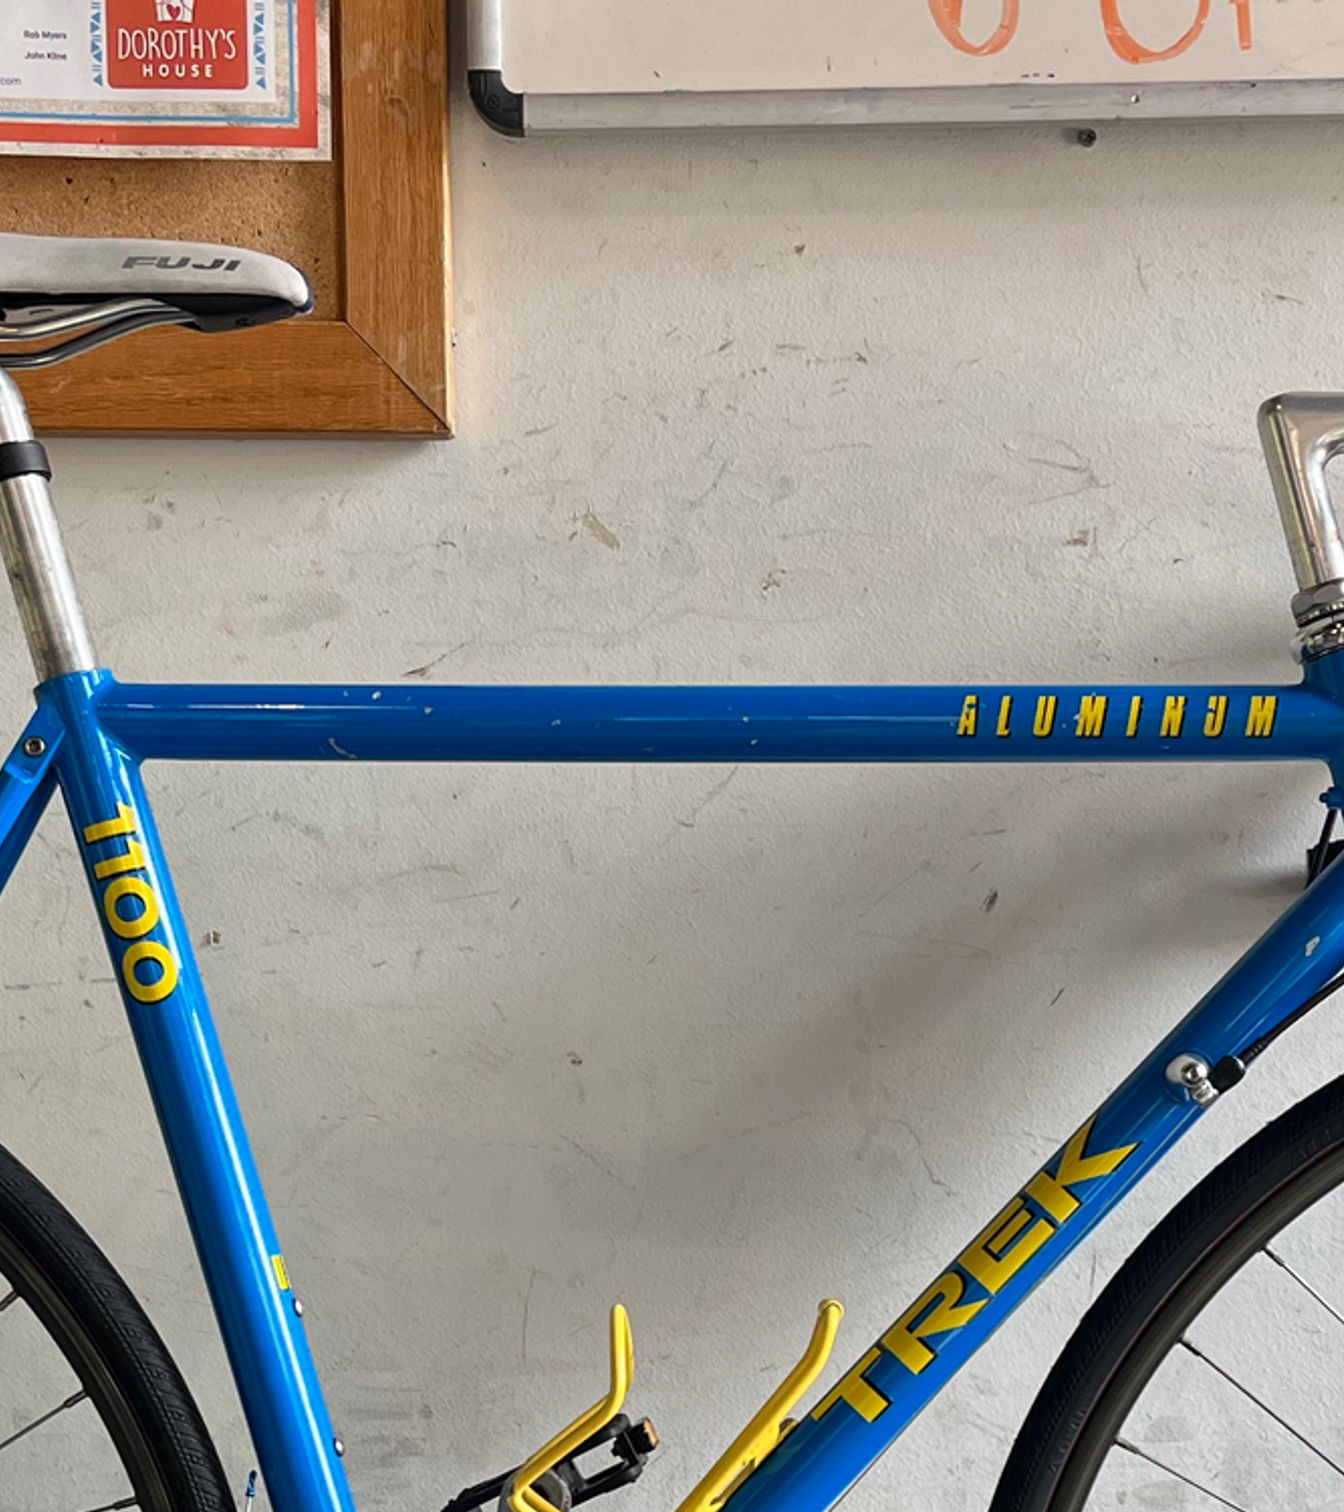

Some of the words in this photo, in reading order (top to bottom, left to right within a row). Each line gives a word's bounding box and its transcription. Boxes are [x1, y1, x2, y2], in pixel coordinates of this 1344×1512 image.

[118, 28, 237, 60] DOROTHY'S
[142, 64, 214, 78] HOUSE
[122, 256, 241, 271] FUJI
[957, 694, 1279, 738] ALUMINUM
[83, 802, 180, 1003] 1100
[812, 1117, 1145, 1424] TREK
